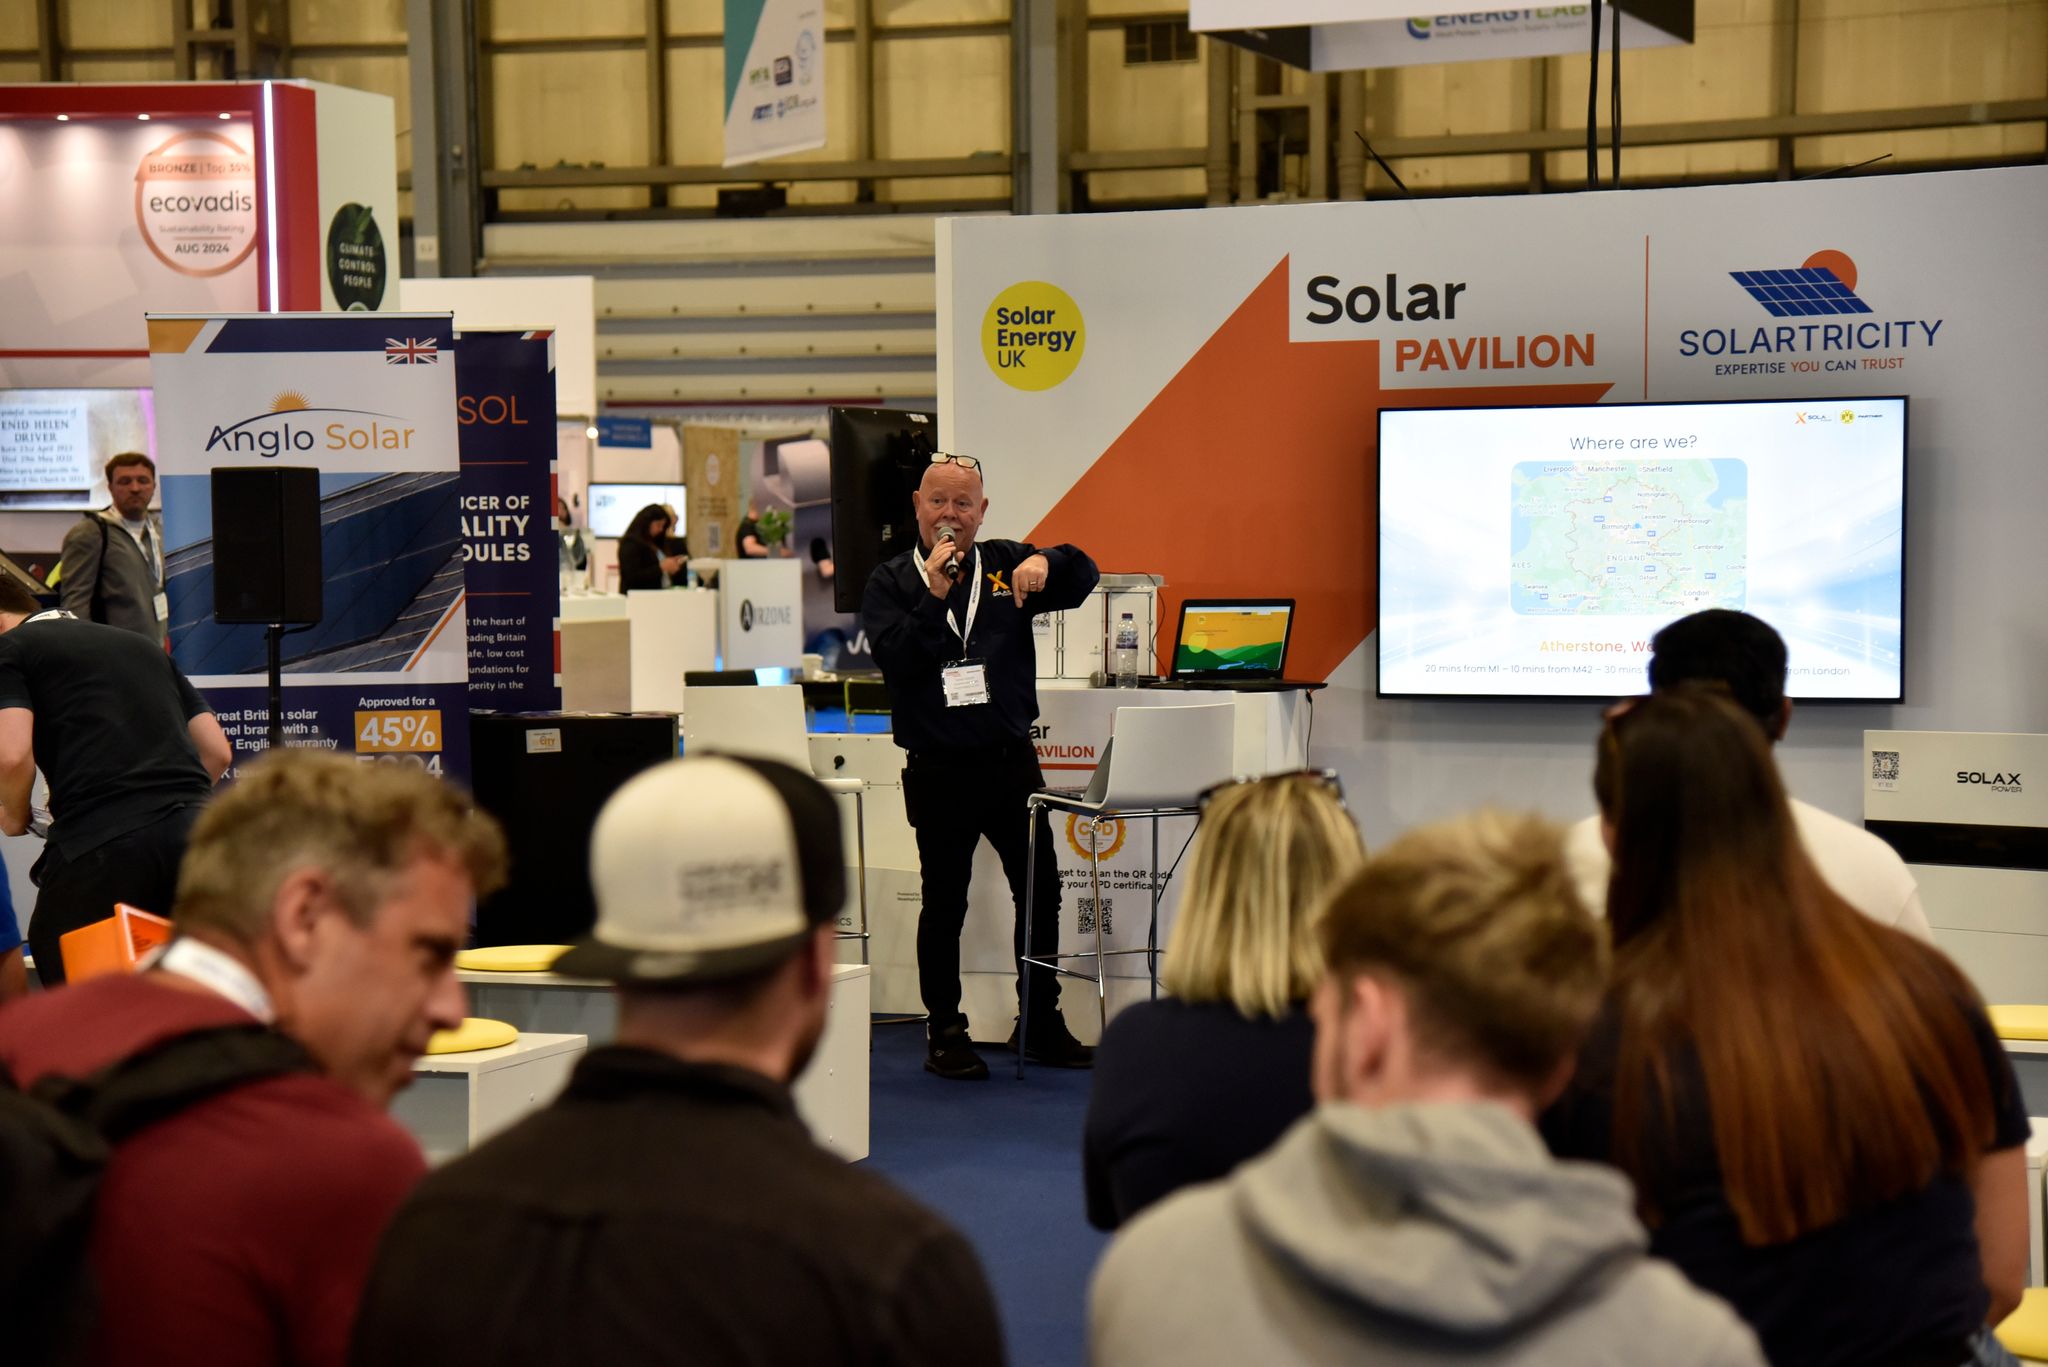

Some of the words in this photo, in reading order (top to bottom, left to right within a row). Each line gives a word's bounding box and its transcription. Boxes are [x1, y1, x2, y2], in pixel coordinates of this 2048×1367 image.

[149, 163, 197, 173] BRONZE
[206, 163, 225, 175] Top
[150, 190, 252, 212] ecovadis
[175, 243, 199, 253] AUG
[202, 243, 230, 253] 2024
[339, 242, 374, 257] CLIMATE
[338, 258, 376, 273] CONTROL
[343, 274, 373, 289] PEOPLE
[1306, 273, 1466, 325] Solar
[996, 306, 1056, 326] Solar
[997, 328, 1077, 352] Energy
[1679, 319, 1943, 357] SOLARTRICITY
[998, 350, 1026, 368] UK
[1396, 333, 1595, 372] PAVILION
[1715, 362, 1786, 376] EXPERTISE
[1791, 361, 1820, 373] YOU
[1824, 359, 1857, 372] CAN
[1861, 357, 1905, 371] TRUST
[458, 394, 528, 425] SOL
[34, 419, 69, 429] HELEN
[15, 432, 57, 443] DRIVER
[205, 423, 314, 458] Anglo
[326, 421, 415, 450] Solar
[1570, 437, 1625, 450] Where
[1630, 438, 1659, 449] are
[1664, 434, 1698, 449] we?
[1543, 465, 1575, 473] Liverpool
[460, 495, 500, 510] CER
[505, 495, 530, 510] OF
[461, 515, 530, 537] ALITY
[1602, 523, 1632, 531] Birmingh
[462, 543, 531, 562] DULES
[473, 617, 488, 626] the
[490, 617, 513, 626] heart
[516, 616, 525, 626] of
[740, 599, 791, 632] AIRZONE
[466, 632, 495, 643] eading
[497, 632, 526, 642] Britain
[487, 649, 503, 658] low
[505, 649, 524, 658] cost
[1540, 640, 1627, 654] Atherstone,
[468, 664, 514, 674] undations
[516, 664, 530, 673] for
[1425, 664, 1436, 673] 20
[1439, 664, 1461, 673] mins
[1463, 664, 1486, 673] from
[1488, 665, 1500, 673] M1
[1511, 665, 1520, 673] 10
[1522, 665, 1545, 673] mins
[1548, 664, 1571, 673] from
[1573, 665, 1593, 674] M42
[1604, 665, 1616, 674] 30
[1618, 664, 1642, 674] mins
[1812, 666, 1850, 676] London
[468, 681, 495, 691] perity
[497, 680, 506, 690] in
[509, 680, 524, 690] the
[358, 697, 409, 708] Approved
[412, 696, 426, 706] for
[429, 698, 435, 706] a
[214, 711, 241, 722] reat
[244, 709, 284, 721] Briti
[287, 709, 318, 720] solar
[222, 725, 240, 736] nel
[282, 723, 308, 734] with
[311, 725, 318, 734] a
[359, 716, 436, 748] 45%
[1030, 725, 1051, 739] ar
[236, 738, 270, 752] Engli
[285, 738, 338, 749] warranty
[1035, 745, 1095, 758] AVILION
[1956, 771, 2021, 785] SOLAX
[1991, 785, 2023, 793] POWER
[1058, 869, 1074, 879] get
[1077, 868, 1087, 877] to
[1089, 870, 1111, 878] san
[1114, 869, 1130, 878] the
[1132, 870, 1147, 879] QR
[1067, 881, 1088, 889] your
[1090, 880, 1111, 889] PD
[1113, 880, 1162, 890] certificae
[836, 917, 852, 926] CS
